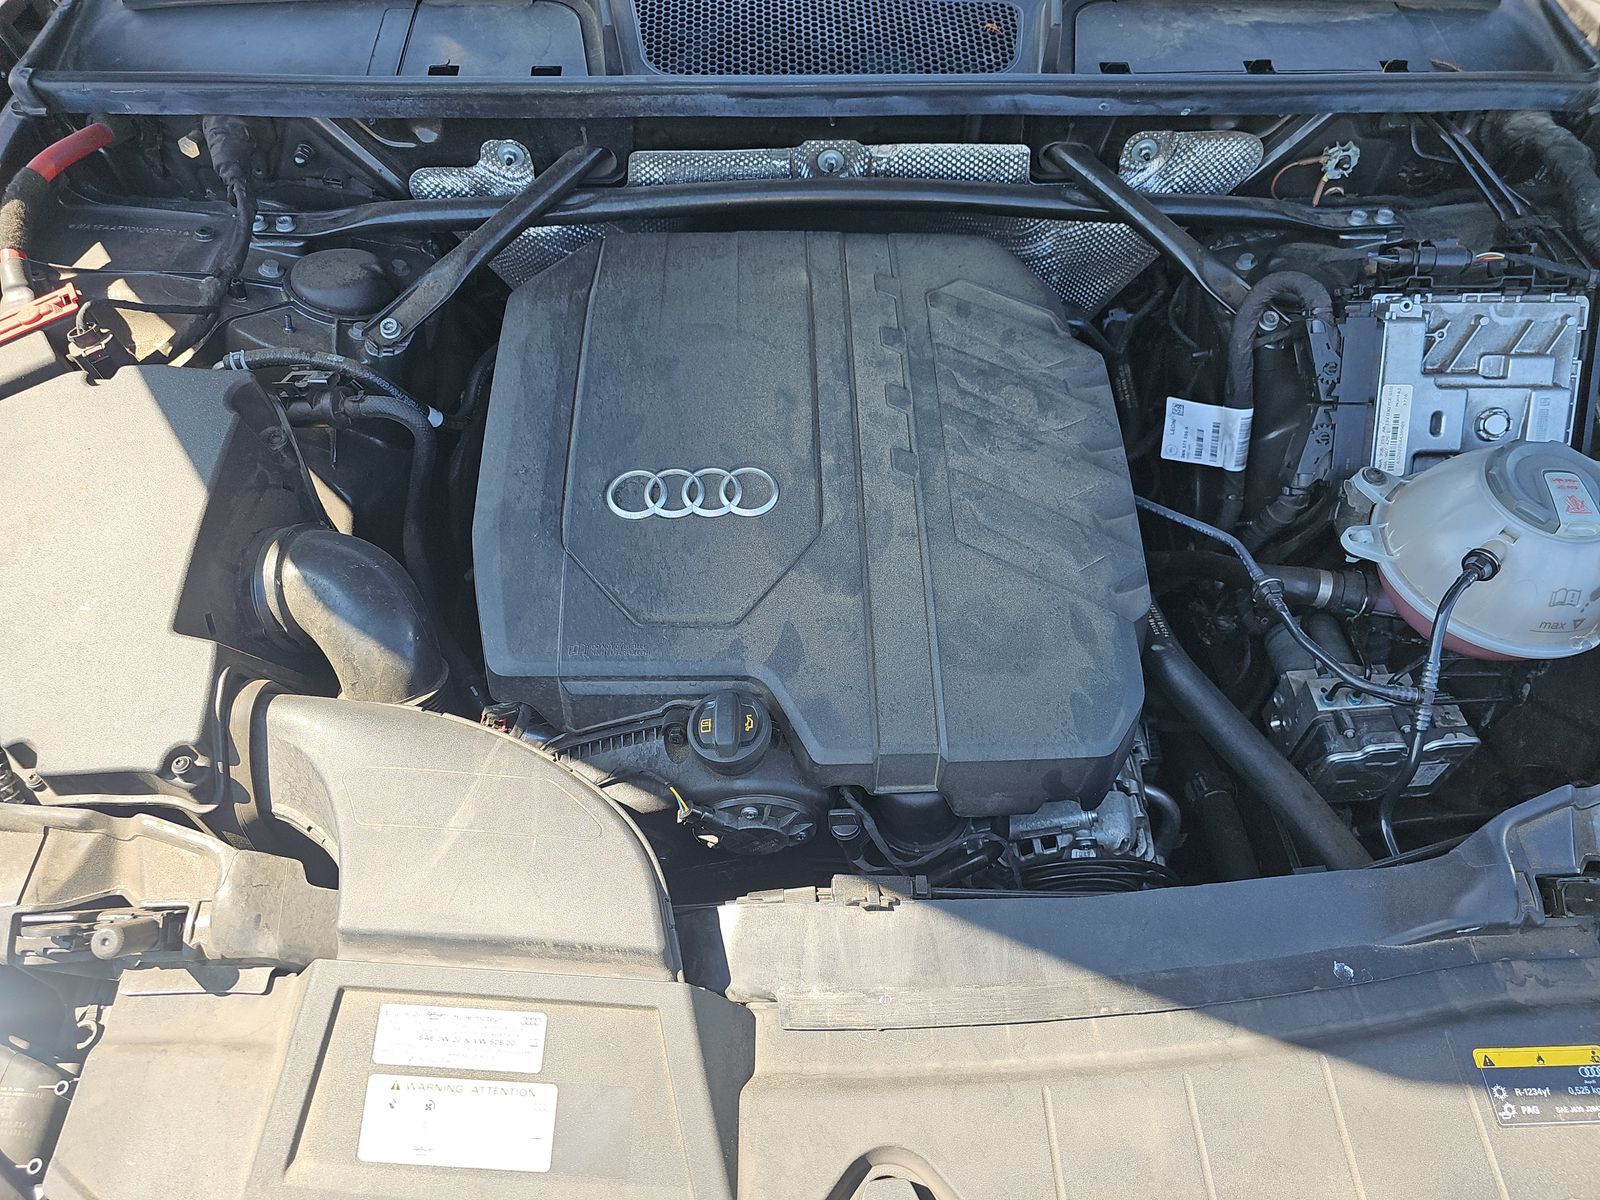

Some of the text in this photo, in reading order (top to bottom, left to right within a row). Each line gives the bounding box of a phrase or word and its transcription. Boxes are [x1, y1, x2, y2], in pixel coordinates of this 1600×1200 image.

[1539, 621, 1567, 630] max
[406, 1082, 537, 1097] WARNING ATTENTION
[1567, 1086, 1591, 1096] 0,525
[1520, 1105, 1540, 1114] PAG
